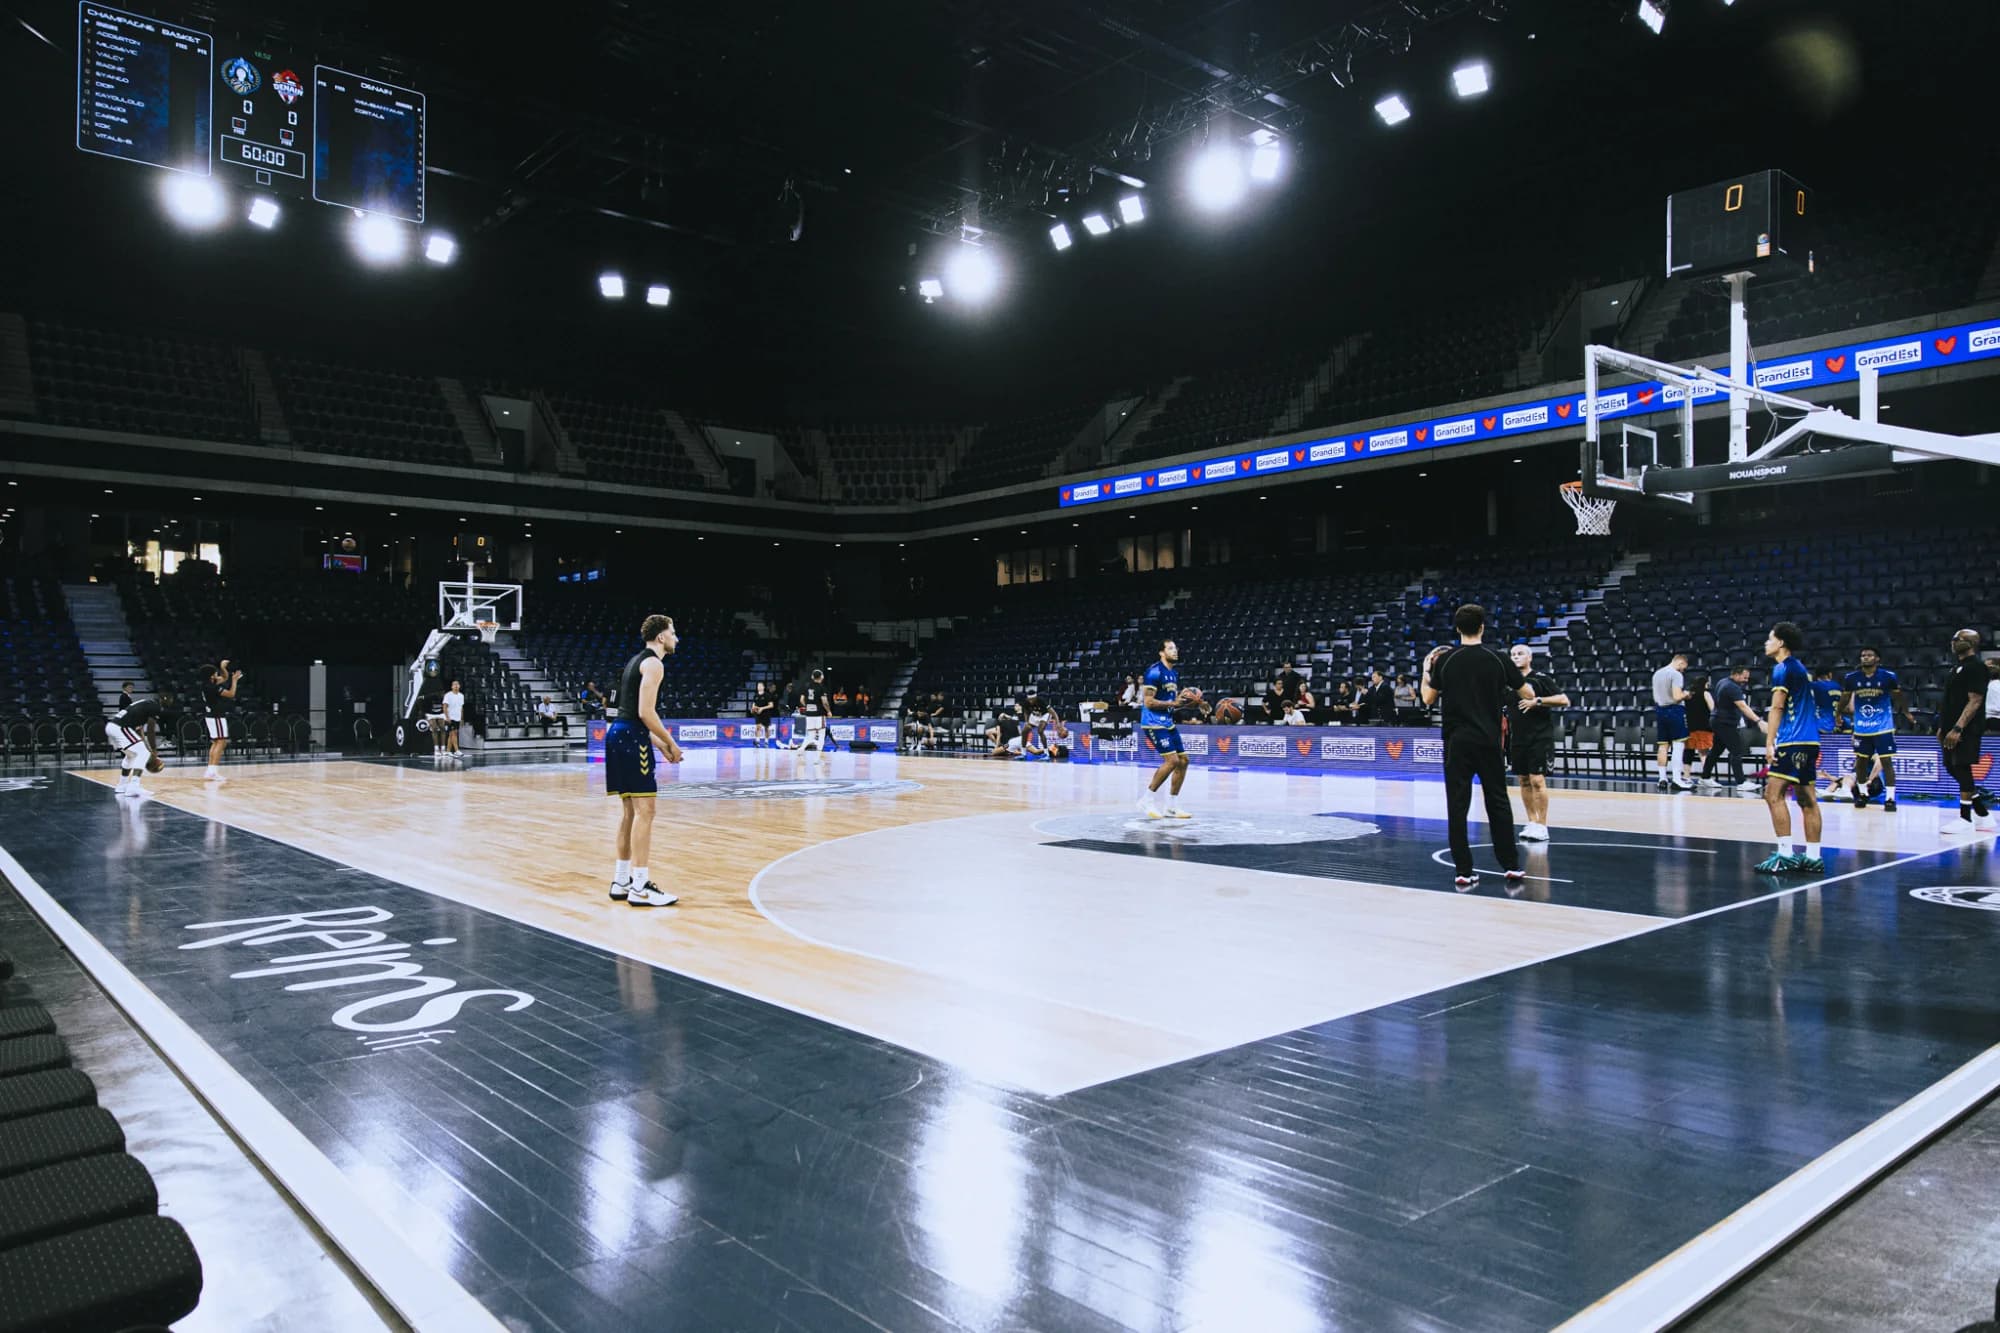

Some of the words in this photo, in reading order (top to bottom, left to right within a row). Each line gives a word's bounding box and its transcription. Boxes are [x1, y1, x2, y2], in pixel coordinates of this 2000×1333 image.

[87, 9, 155, 32] CHAMPAGNE
[161, 28, 201, 44] BASKET
[243, 99, 253, 115] 0
[288, 110, 298, 126] 0
[242, 144, 285, 167] 60:00
[1724, 183, 1744, 212] 0
[1729, 465, 1788, 480] NOUANSPORT
